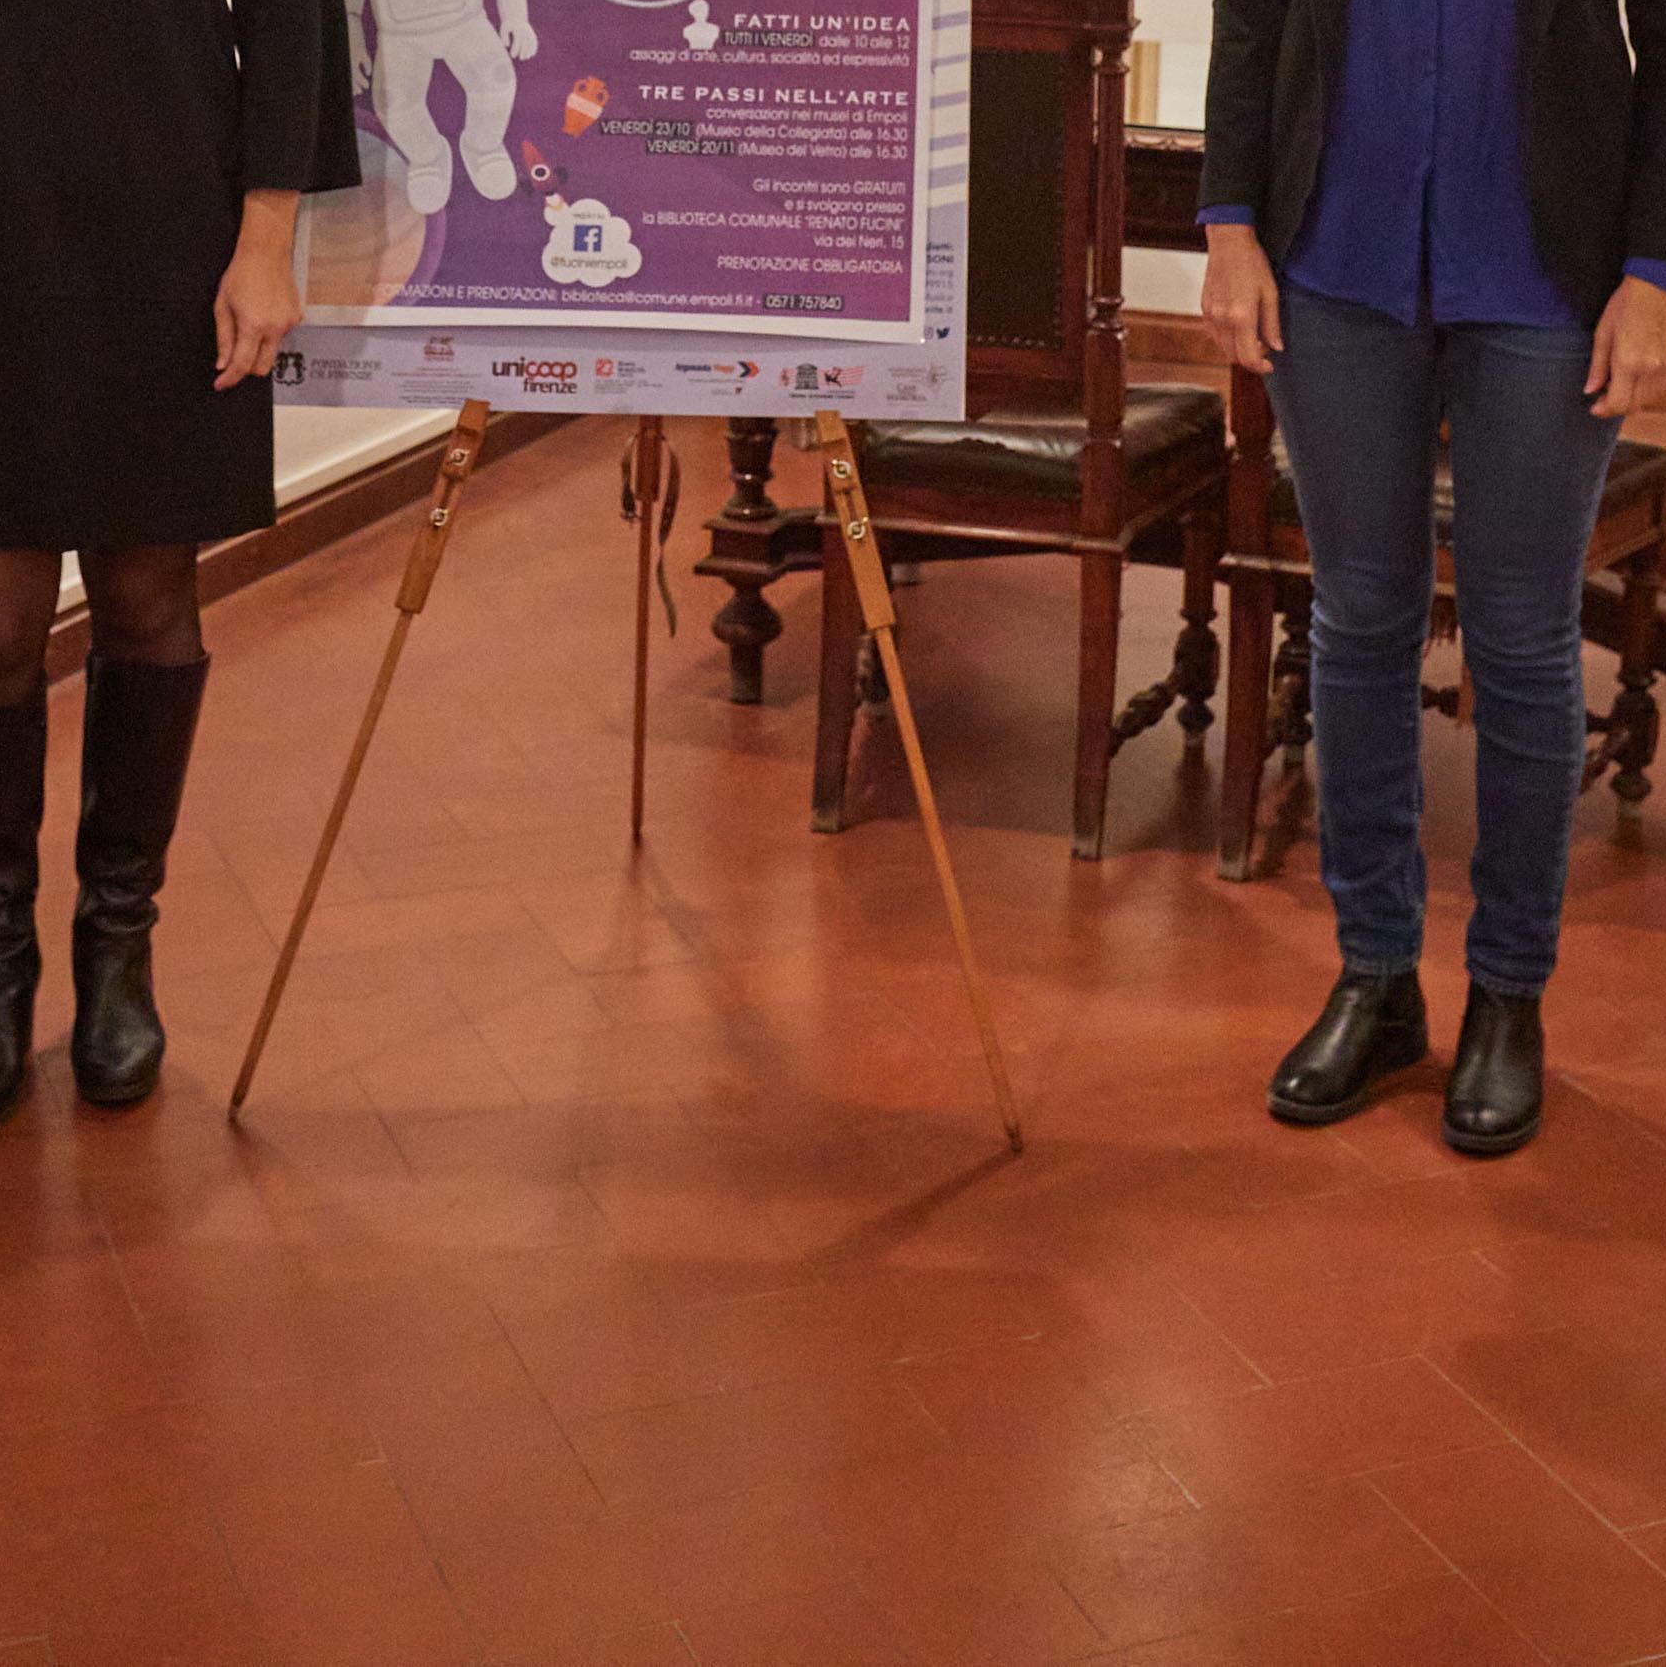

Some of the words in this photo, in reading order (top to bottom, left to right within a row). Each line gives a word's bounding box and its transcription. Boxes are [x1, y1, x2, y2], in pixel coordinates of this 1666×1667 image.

[733, 14, 800, 30] FATTI
[809, 16, 910, 32] UN'IDEA
[724, 31, 753, 45] TUTTI
[818, 35, 850, 48] dalle
[854, 35, 868, 48] 10
[869, 36, 893, 49] alle
[897, 35, 910, 49] 12
[630, 50, 675, 65] assaggi
[678, 49, 689, 62] di
[822, 53, 840, 65] ed
[638, 85, 685, 101] TRE
[694, 86, 765, 102] PASSI
[775, 88, 909, 106] NELL'ARTE
[705, 107, 789, 121] conversazioni
[792, 109, 811, 121] nei
[813, 110, 850, 122] musei
[852, 110, 864, 122] di
[866, 109, 908, 124] Empoli
[655, 121, 691, 136] 23/10
[695, 123, 742, 137] (Museo
[744, 124, 775, 138] della
[778, 125, 847, 142] Collegiata)
[850, 127, 873, 140] alle
[877, 127, 908, 141] 16.30
[701, 140, 735, 155] 20/11
[738, 141, 784, 156] (Museo
[786, 143, 806, 156] del
[849, 146, 873, 158] alle
[877, 145, 907, 159] 16.30
[753, 178, 771, 192] Gli
[772, 180, 819, 193] incontri
[821, 181, 850, 194] sono
[784, 200, 794, 211] e
[796, 199, 805, 211] si
[807, 199, 864, 214] svolgono
[865, 202, 905, 213] presso
[642, 211, 655, 225] la
[656, 211, 727, 226] BIBLIOTECA
[728, 213, 802, 229] COMUNALE
[813, 235, 833, 247] via
[891, 235, 905, 249] 15
[717, 255, 811, 271] PRENOTAZIONE
[813, 259, 903, 273] OBBLIGATORIA
[457, 285, 466, 299] E
[766, 295, 795, 308] 0571
[798, 295, 842, 311] 757840
[492, 356, 578, 381] unicoop
[523, 377, 578, 394] firenze
